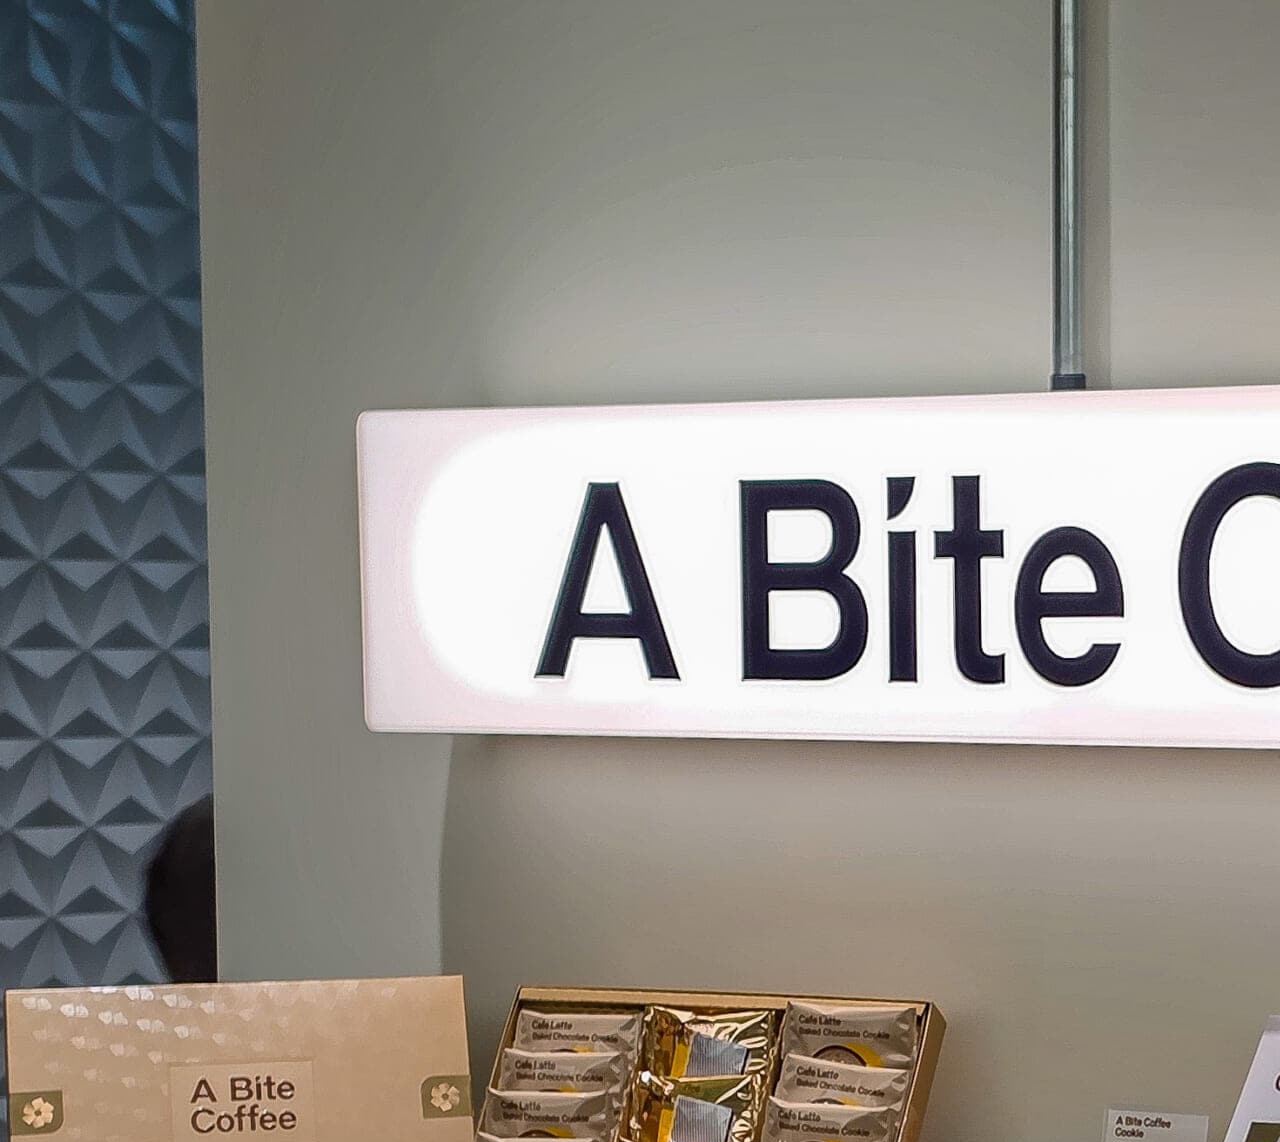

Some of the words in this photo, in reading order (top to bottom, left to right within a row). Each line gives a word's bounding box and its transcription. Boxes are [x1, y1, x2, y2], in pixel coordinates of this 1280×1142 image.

[534, 481, 681, 681] A
[738, 474, 1124, 688] Bite
[191, 1079, 217, 1103] A
[230, 1076, 295, 1101] Bite
[191, 1104, 297, 1133] Coffee
[1116, 1116, 1124, 1125] A
[1125, 1117, 1142, 1127] Bite
[1144, 1117, 1172, 1129] Coffee
[1115, 1127, 1144, 1138] Cookie
